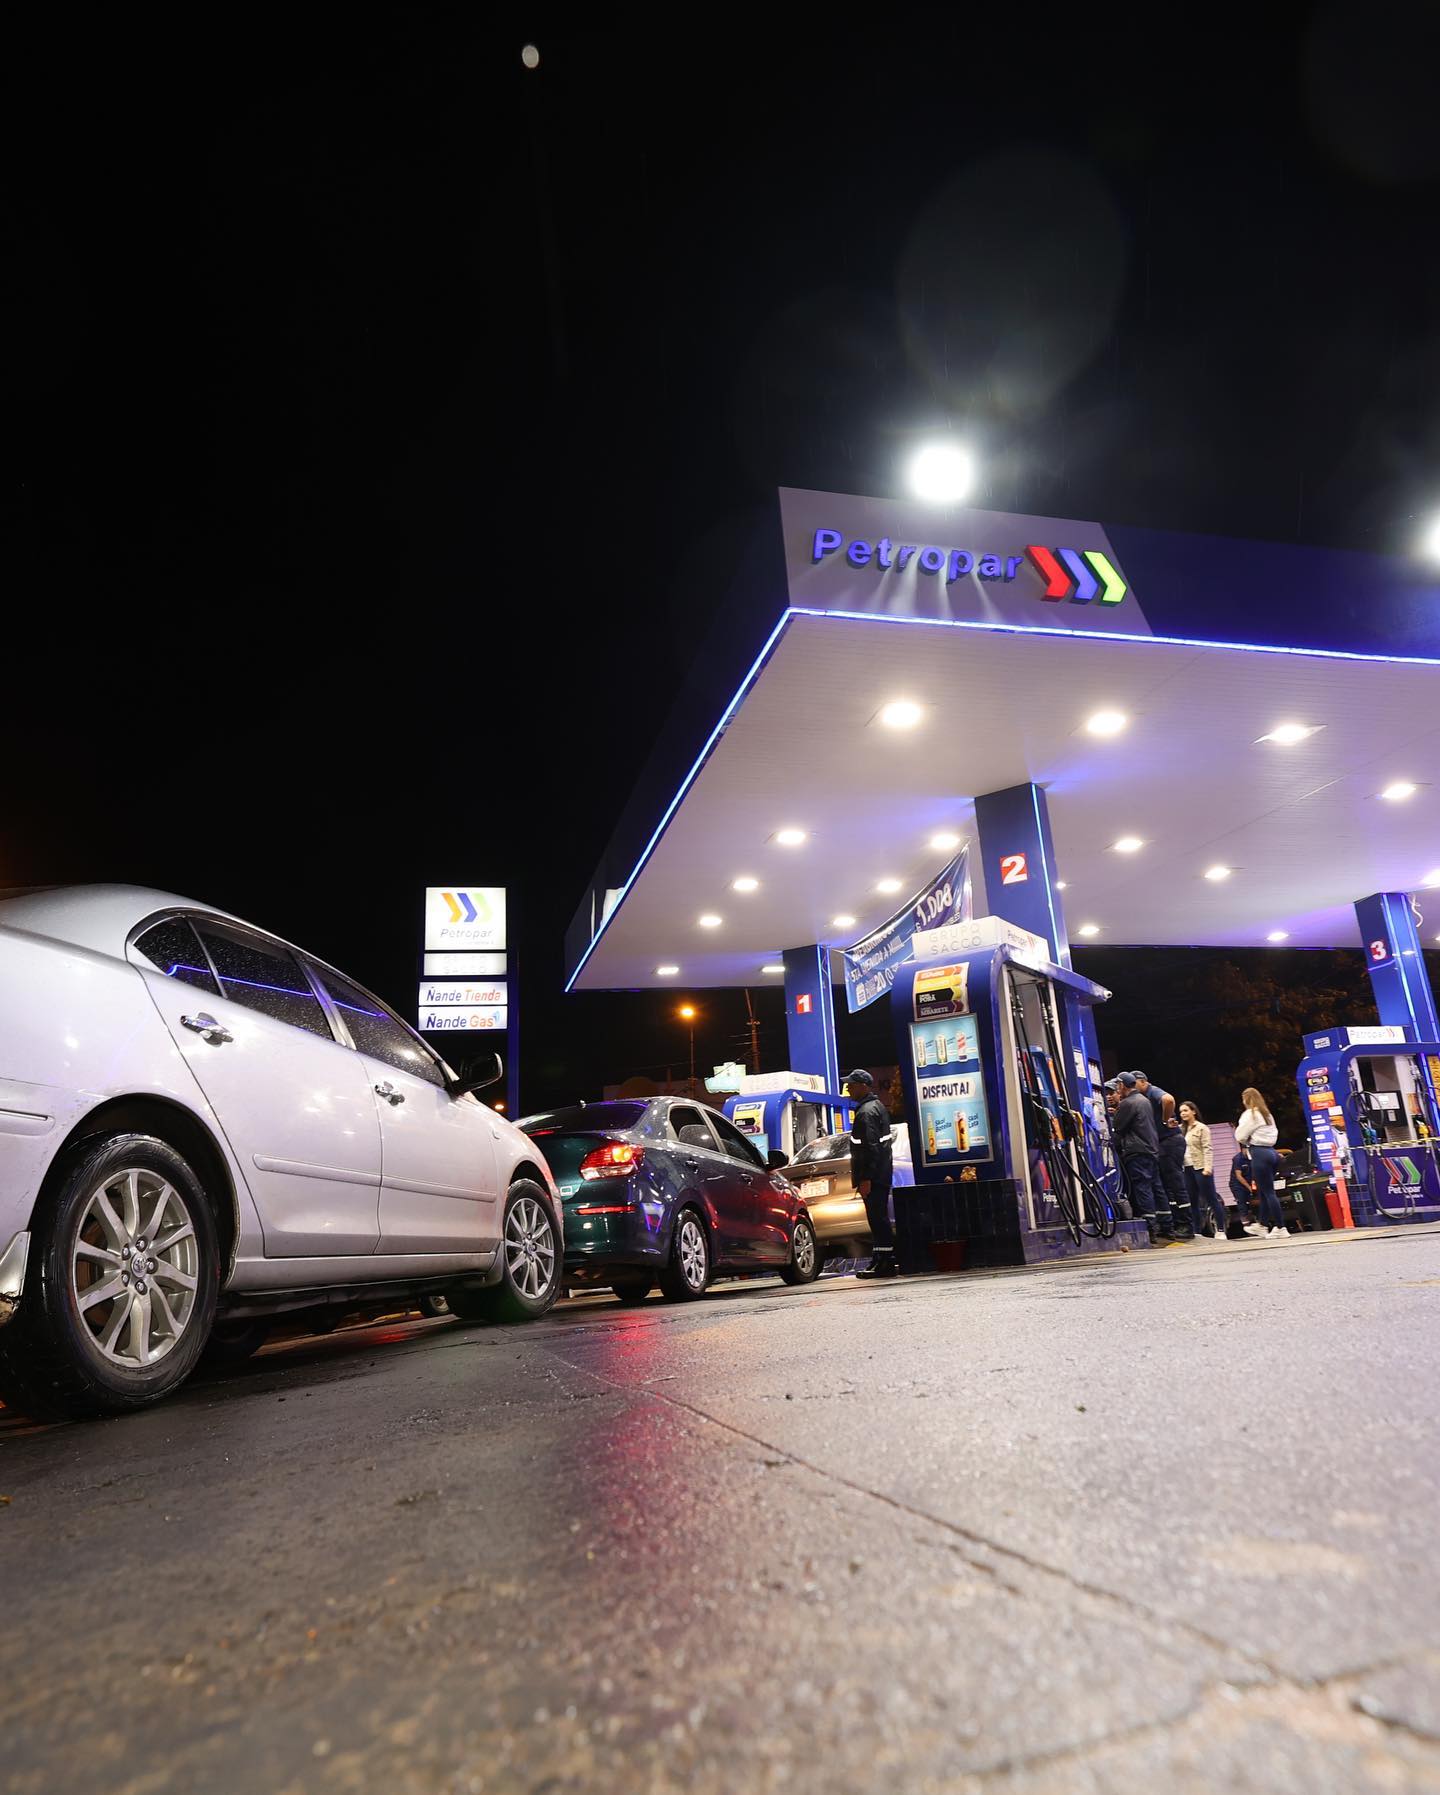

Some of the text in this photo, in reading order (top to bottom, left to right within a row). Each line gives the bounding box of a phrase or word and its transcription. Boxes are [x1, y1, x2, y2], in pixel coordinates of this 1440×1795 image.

[812, 528, 1024, 583] Petropar
[1001, 855, 1028, 885] 2
[440, 928, 493, 940] Petropar
[929, 923, 980, 943] GRUPO
[930, 935, 982, 955] SACCO
[1370, 940, 1387, 961] 3
[426, 986, 501, 1002] Ñande Tienda
[798, 994, 811, 1013] 1
[426, 1013, 494, 1028] Ñande Gas
